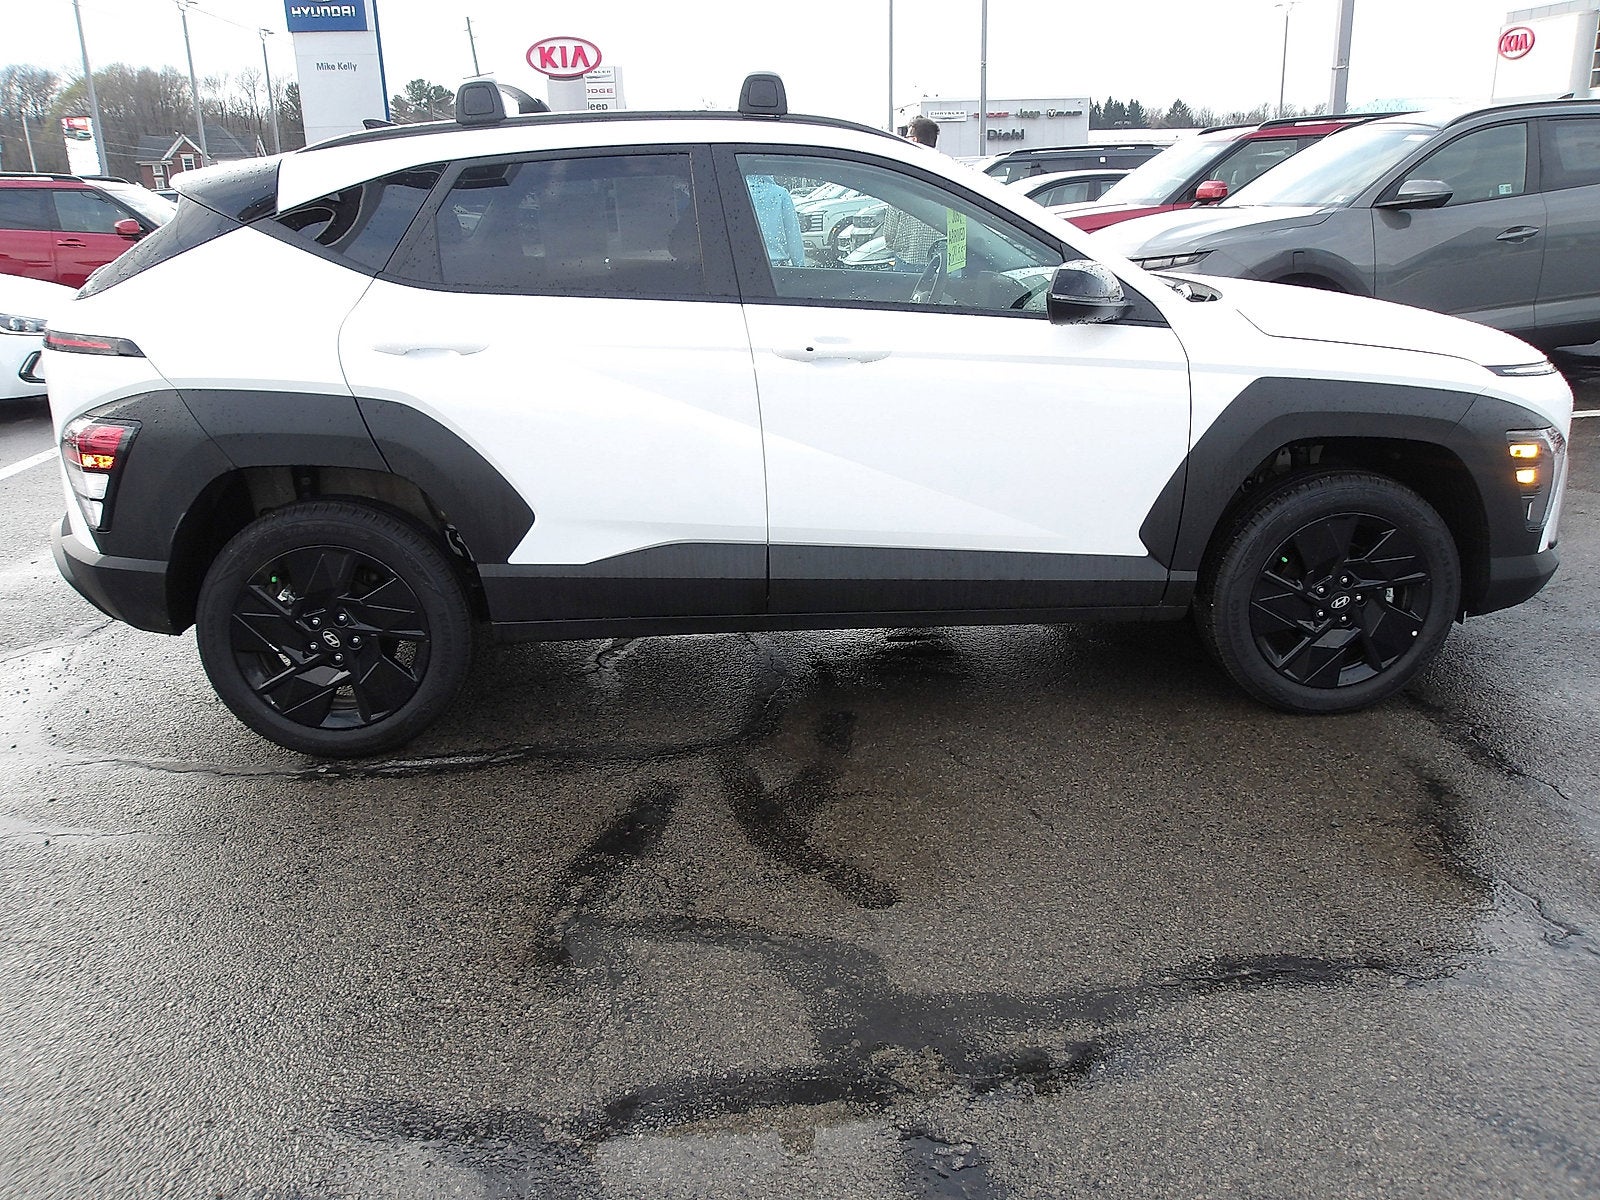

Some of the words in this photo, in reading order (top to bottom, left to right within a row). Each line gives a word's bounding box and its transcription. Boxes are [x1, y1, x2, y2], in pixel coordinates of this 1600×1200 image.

[291, 5, 356, 18] HYUNDAI
[1502, 33, 1528, 53] KIA
[538, 46, 590, 69] KIA
[316, 62, 336, 71] Mike
[337, 62, 358, 72] Kelly
[987, 128, 1025, 141] Diehl
